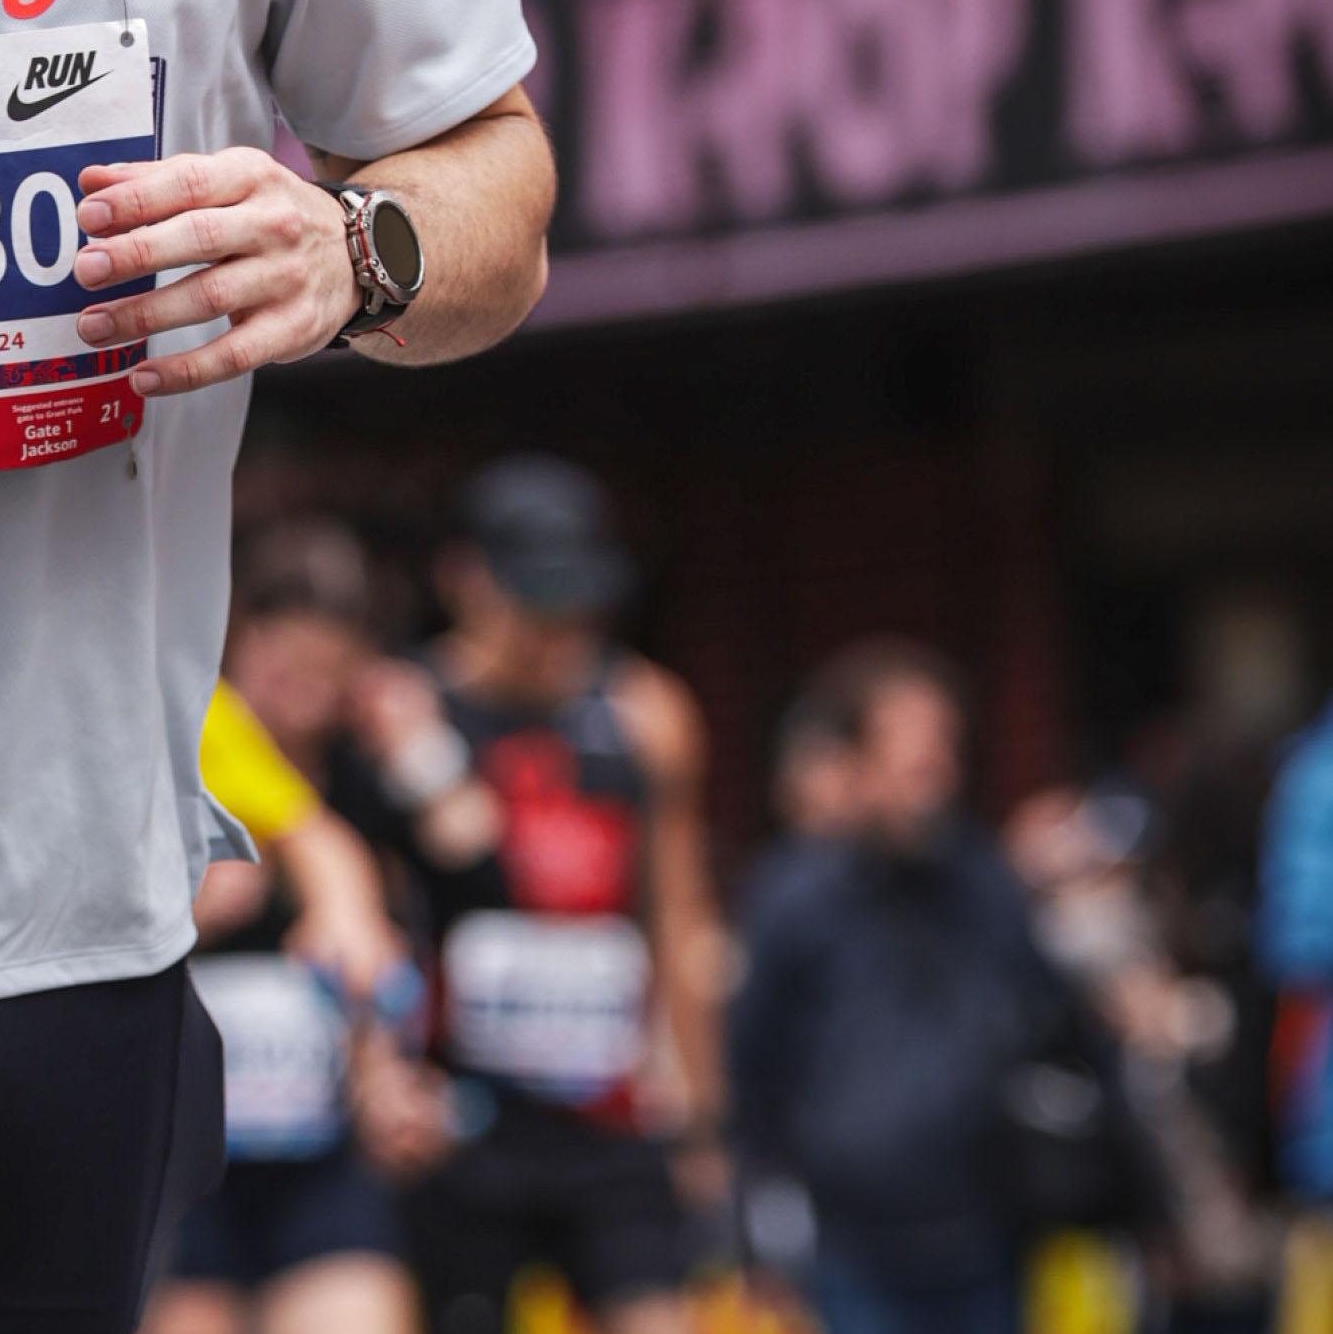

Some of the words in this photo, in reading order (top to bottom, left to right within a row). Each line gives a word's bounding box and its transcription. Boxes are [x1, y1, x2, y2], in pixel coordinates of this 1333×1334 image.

[24, 50, 97, 91] RUN
[99, 400, 121, 423] 21
[25, 425, 61, 439] Gate
[65, 419, 73, 433] 1
[20, 438, 78, 461] Jackson
